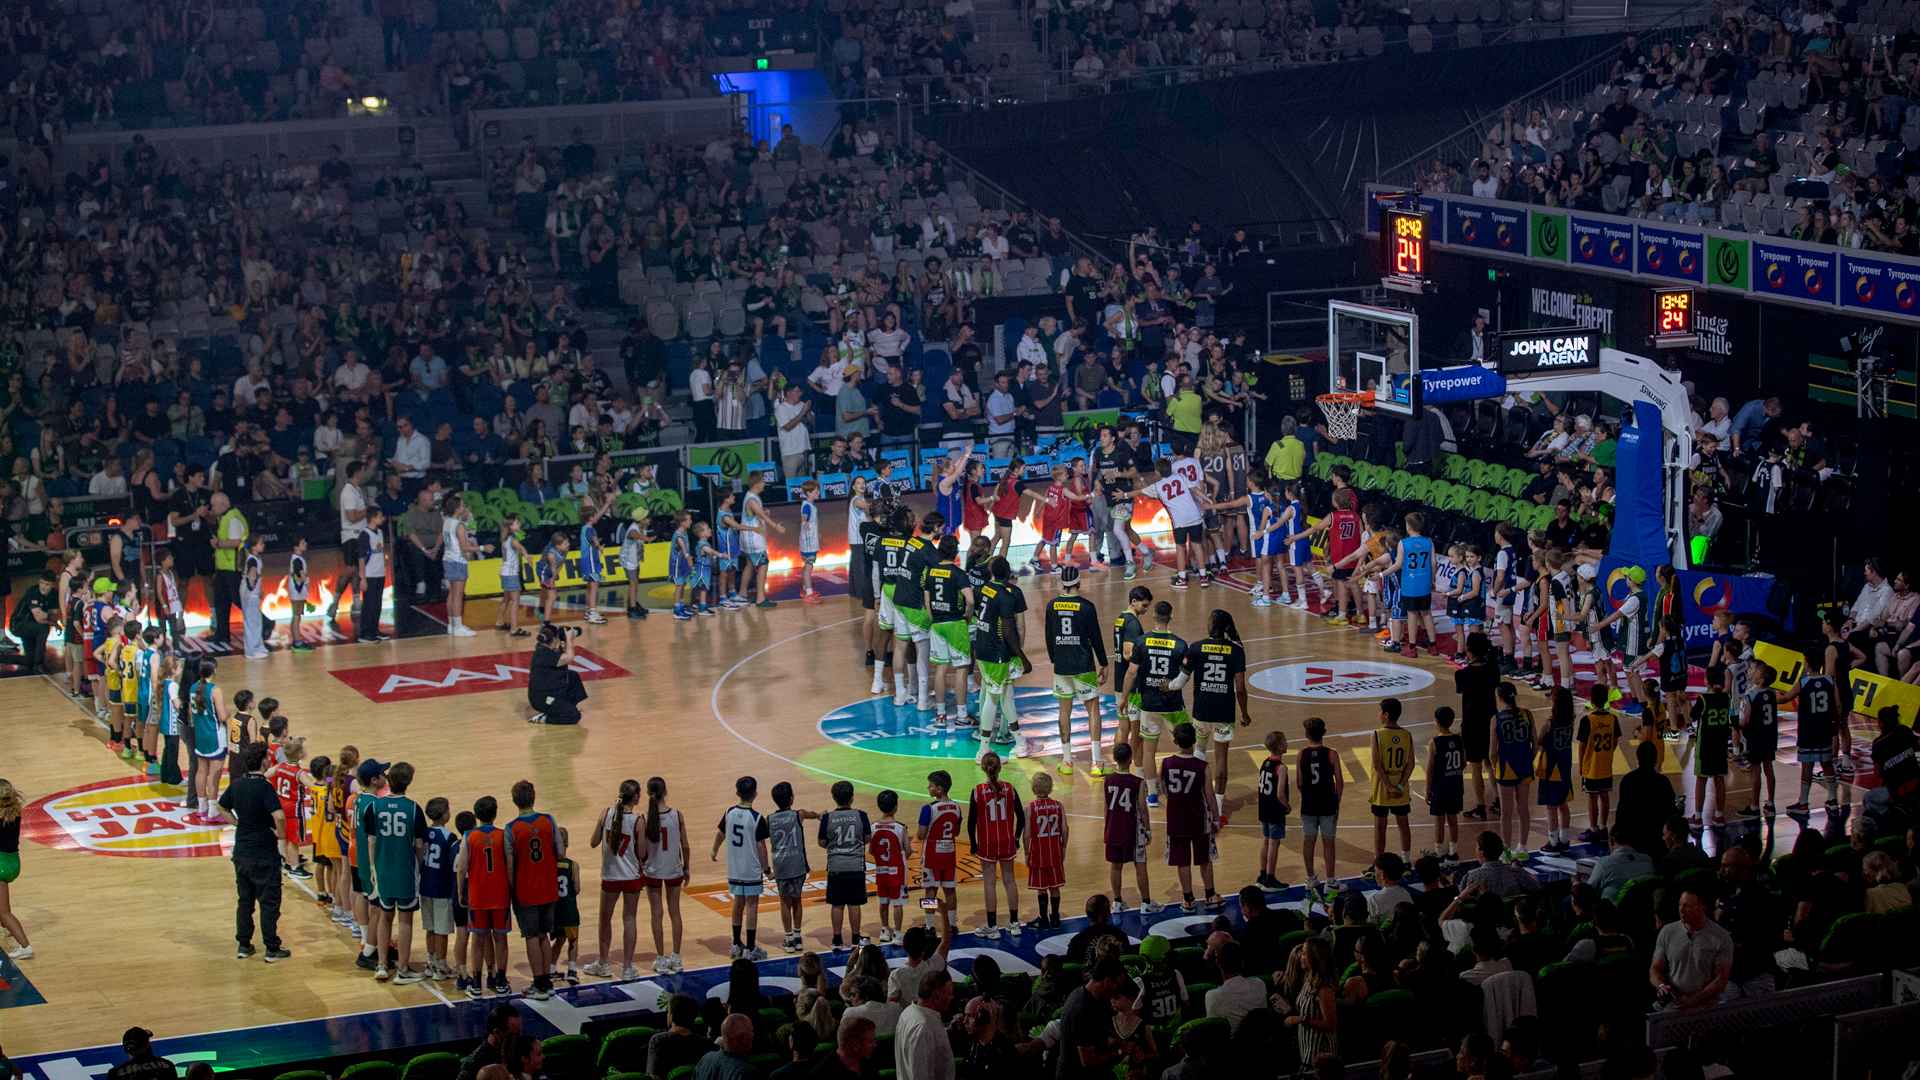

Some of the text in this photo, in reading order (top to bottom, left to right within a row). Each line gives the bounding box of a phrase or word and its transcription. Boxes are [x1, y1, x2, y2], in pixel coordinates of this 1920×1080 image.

[748, 19, 772, 29] EXIT
[1456, 207, 1482, 219] Tyrepower
[1491, 212, 1518, 224] Tyrepower
[1396, 217, 1422, 239] 13:42
[1573, 223, 1600, 235] Tyrepower
[1604, 227, 1631, 239] Tyrepower
[1640, 232, 1668, 245] Tyrepower
[1672, 237, 1701, 249] Tyrepower
[1397, 237, 1421, 272] 24
[1759, 250, 1791, 262] Tyrepower
[1797, 255, 1829, 268] Tyrepower
[1848, 262, 1881, 276] Tyrepower
[1531, 288, 1576, 320] WELCOME
[1662, 294, 1688, 310] 13:42
[1576, 304, 1613, 335] FIREPIT
[1663, 311, 1683, 330] 24
[1509, 336, 1589, 356] JOHN CAIN
[1696, 332, 1733, 356] hittle
[1536, 350, 1589, 366] ARENA
[1423, 376, 1482, 393] Tyrepower
[1639, 384, 1668, 411] SPALDING
[1026, 463, 1048, 472] POWER
[1204, 456, 1224, 473] 20
[1233, 453, 1246, 471] 81
[823, 484, 845, 492] POWER
[1162, 479, 1185, 500] 22
[1339, 522, 1355, 540] 27
[887, 551, 897, 567] 0
[1407, 551, 1429, 570] 37
[935, 584, 944, 601] 2
[979, 602, 987, 620] 7
[1061, 617, 1072, 635] 8
[1147, 638, 1175, 648] STANLEY
[1203, 644, 1230, 653] STANLEY
[1149, 655, 1170, 676] 13
[1203, 662, 1227, 682] 25
[1207, 682, 1228, 690] UNITED
[1300, 674, 1413, 695] MITSUBISHI
[1327, 680, 1404, 696] MOTORS
[1810, 691, 1829, 713] 13
[1708, 708, 1729, 726] 23
[1762, 703, 1774, 725] 3
[1501, 717, 1529, 743] 85
[1593, 733, 1612, 752] 23
[1387, 746, 1404, 769] 10
[1445, 749, 1461, 771] 20
[1168, 768, 1197, 794] 57
[1310, 762, 1320, 785] 5
[276, 776, 291, 800] 12
[1108, 785, 1133, 812] 74
[831, 815, 858, 823] BAYSIDE
[986, 798, 1007, 822] 11
[378, 811, 407, 837] 36
[942, 821, 953, 839] 2
[1036, 814, 1060, 838] 22
[732, 825, 744, 847] 5
[774, 826, 799, 850] 21
[833, 825, 856, 846] 14
[528, 837, 543, 863] 8
[878, 838, 891, 862] 3
[483, 847, 493, 873] 1
[1151, 994, 1178, 1019] 30
[116, 1061, 172, 1077] CIRCUS
